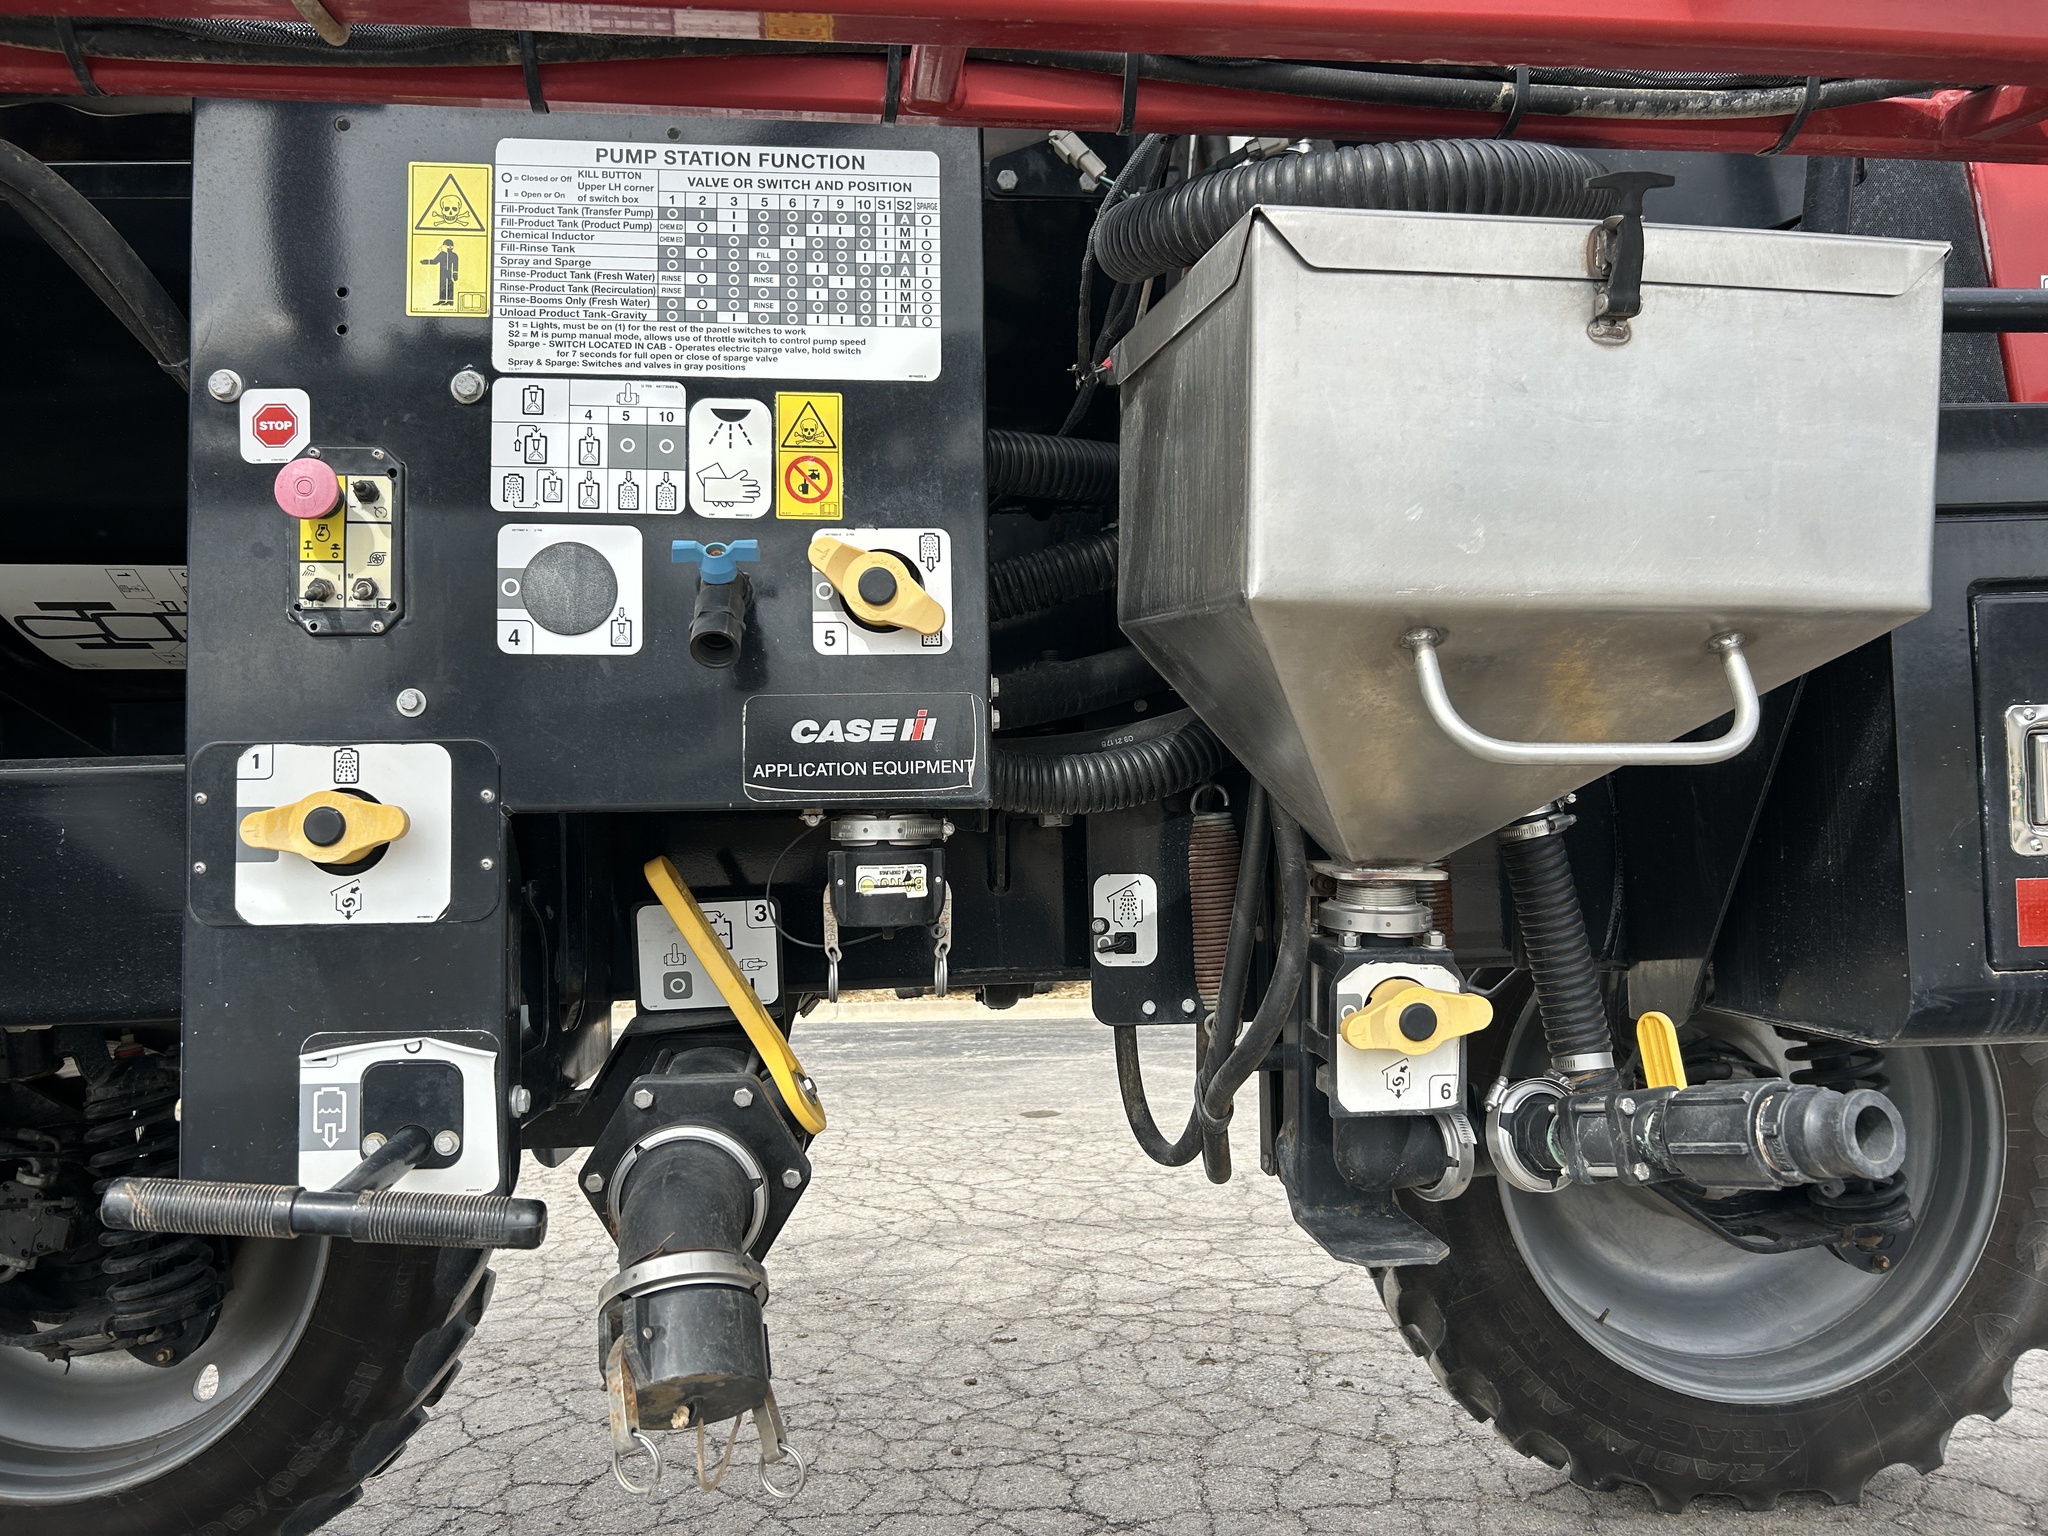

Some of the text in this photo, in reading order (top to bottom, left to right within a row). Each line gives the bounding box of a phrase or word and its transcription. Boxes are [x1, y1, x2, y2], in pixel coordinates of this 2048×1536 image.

[596, 148, 864, 170] PUMP STATION FUNCTION
[602, 171, 642, 180] BUTTON
[578, 182, 606, 192] Upper
[688, 177, 912, 192] VALVE OR SWITCH AND POSITION
[670, 195, 675, 204] 1
[699, 196, 706, 205] 2
[731, 197, 738, 206] 3
[761, 198, 768, 207] 5
[790, 198, 796, 207] 6
[813, 199, 820, 208] 7
[837, 199, 844, 208] 9
[857, 200, 871, 210] 10
[877, 200, 892, 210] S1
[897, 201, 912, 211] S2
[501, 205, 654, 219] Fill-Product Tank (Transfer Pump)
[501, 218, 554, 227] Fill-Product
[557, 220, 578, 228] Tank
[582, 220, 620, 231] (Product
[623, 222, 652, 232] Pump)
[501, 230, 548, 240] Chemical
[552, 232, 595, 241] Inductor
[501, 243, 548, 252] Fill-Rinse
[552, 245, 575, 253] Tank
[500, 256, 530, 266] Spray
[555, 258, 591, 268] Sparge
[501, 269, 567, 278] Rinse-Product
[570, 271, 591, 279] Tank
[594, 272, 622, 281] (Fresh
[625, 272, 655, 282] Water)
[500, 283, 565, 292] Rinse-Product
[568, 285, 588, 293] Tank
[591, 285, 656, 297] (Recirculation)
[500, 295, 562, 304] Rinse-Booms
[566, 297, 586, 306] Only
[589, 297, 618, 307] (Fresh
[620, 298, 650, 308] Water)
[500, 308, 647, 321] Unload Product Tank-Gravity
[531, 322, 560, 330] Lights,
[615, 324, 625, 332] (1)
[706, 326, 730, 335] panel
[614, 331, 641, 341] mode,
[704, 335, 735, 343] throttle
[840, 338, 866, 347] speed
[508, 340, 540, 349] Sparge
[675, 344, 715, 353] Operates
[834, 345, 861, 354] switch
[508, 358, 534, 367] Spray
[545, 359, 579, 368] Sparge:
[644, 360, 671, 369] valves
[706, 361, 746, 372] positions
[756, 354, 778, 362] valve
[585, 410, 674, 422] 4 5 10
[259, 421, 292, 431] STOP
[508, 629, 520, 645] 4
[824, 630, 836, 646] 5
[790, 719, 898, 744] CASE
[252, 753, 260, 769] 1
[753, 760, 973, 778] APPLICATION EQUIPMENT
[754, 905, 767, 922] 3
[1441, 1083, 1451, 1099] 6
